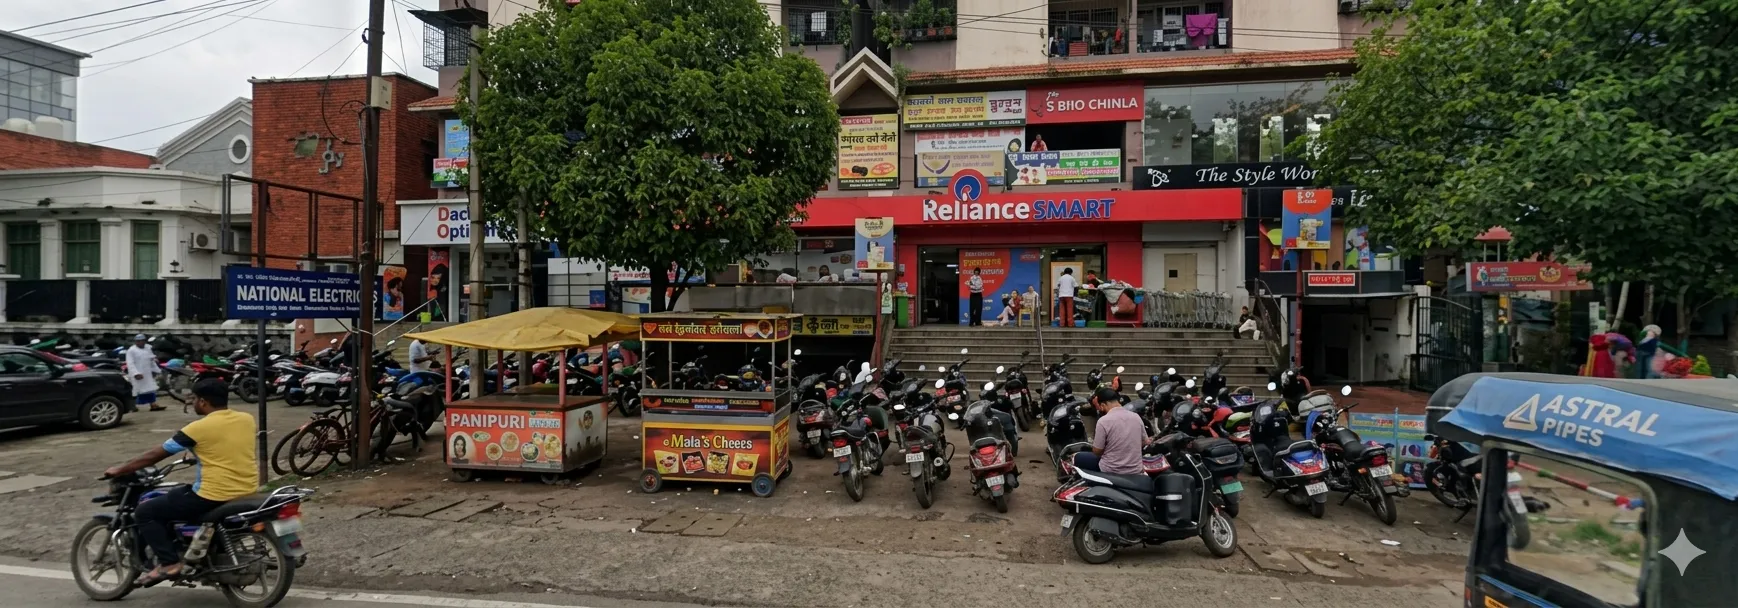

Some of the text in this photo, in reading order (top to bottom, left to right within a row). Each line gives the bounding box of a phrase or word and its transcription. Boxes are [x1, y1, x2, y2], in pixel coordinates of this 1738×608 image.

[1088, 97, 1138, 110] CHINLA
[1196, 165, 1319, 185] The Style Wor
[923, 194, 1115, 221] Reliance SMART
[237, 285, 306, 302] NATIONAL
[451, 413, 525, 429] PANIPURI
[1540, 394, 1660, 437] ASTRAL
[1542, 417, 1604, 447] PIPES
